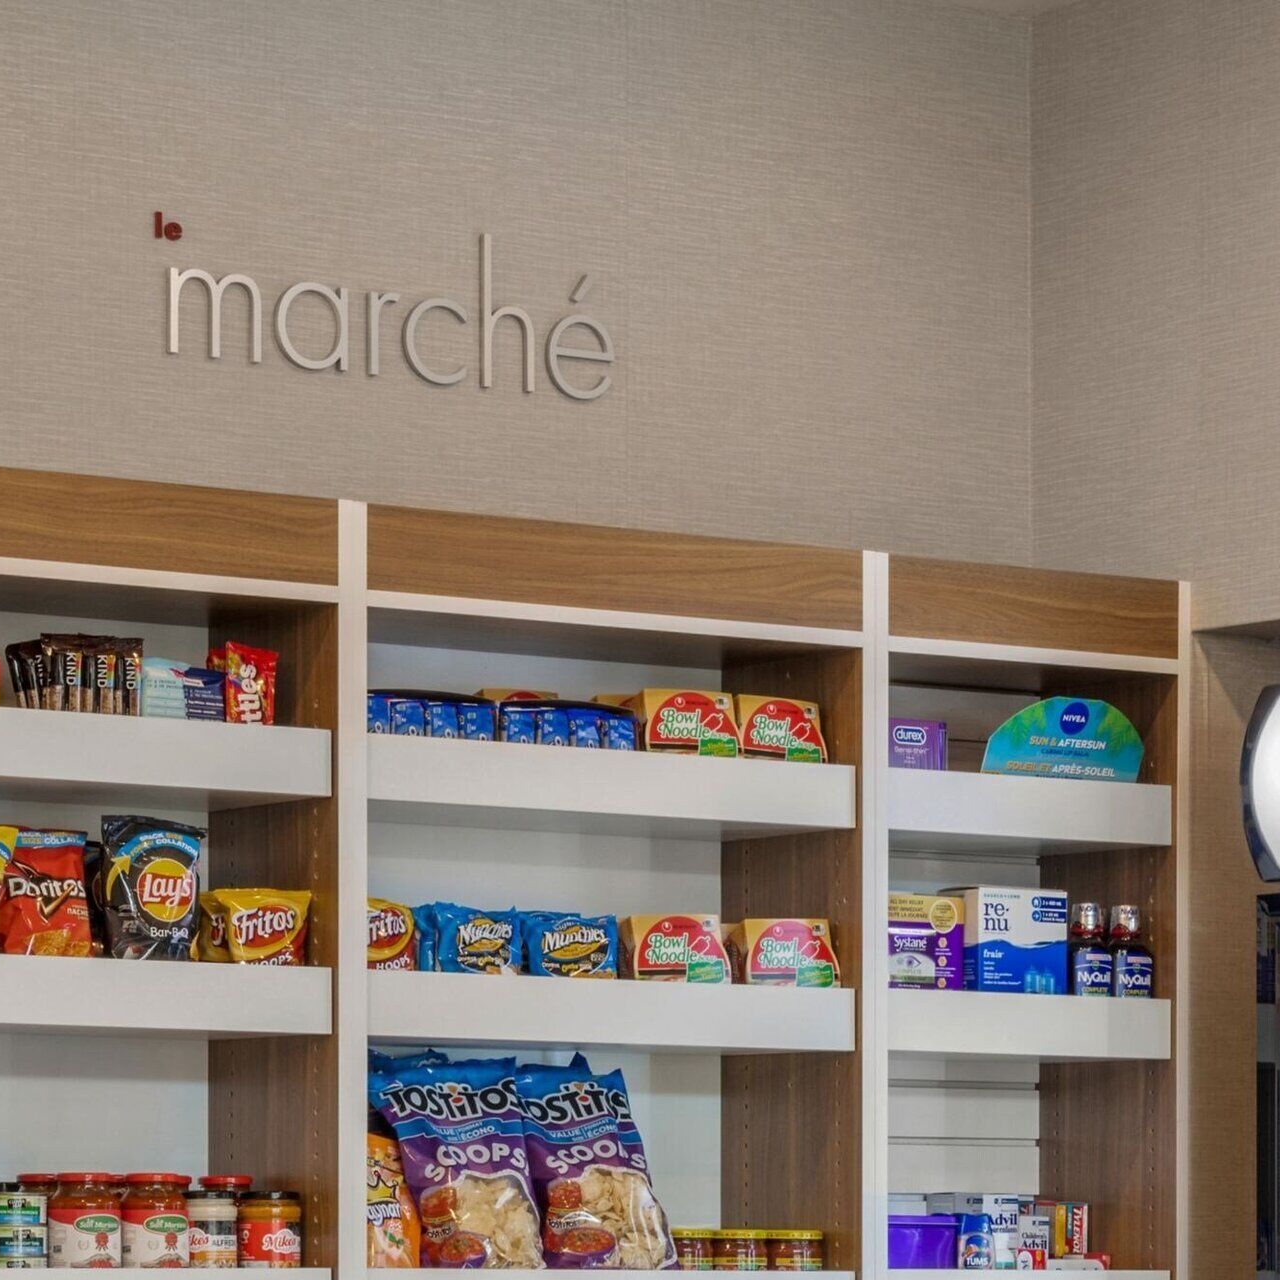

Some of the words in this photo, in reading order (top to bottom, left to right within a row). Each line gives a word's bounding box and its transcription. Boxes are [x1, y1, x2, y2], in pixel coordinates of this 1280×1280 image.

[153, 211, 183, 241] le
[166, 232, 614, 401] marché
[66, 652, 77, 686] KIND
[97, 655, 108, 688] KIND
[125, 657, 136, 690] KIND
[661, 708, 701, 724] Bowl
[754, 714, 792, 732] Bowl
[1062, 714, 1086, 723] NIVEA
[657, 722, 711, 739] Noodle
[751, 729, 798, 748] Noodle
[896, 728, 924, 743] durex
[1029, 735, 1048, 746] SUN
[1057, 738, 1107, 750] AFTERSUN
[1052, 762, 1116, 777] APRÈS-SOLEIL
[8, 877, 87, 898] Doritos
[142, 873, 192, 907] Lay's
[231, 907, 295, 945] Fritos
[542, 925, 606, 954] Munchies
[648, 932, 689, 949] Bowl
[761, 937, 799, 953] Bowl
[375, 956, 410, 971] HOOPS
[646, 947, 698, 963] Noodle
[758, 951, 807, 968] Noodle
[1077, 971, 1111, 986] NyQuil
[1119, 973, 1152, 988] NyQuil
[381, 1077, 521, 1120] TOSTITOS
[549, 1128, 582, 1139] VALUE
[1072, 1207, 1083, 1255] TYLENOL
[1021, 1239, 1048, 1250] Advil
[966, 1256, 989, 1266] TUMS
